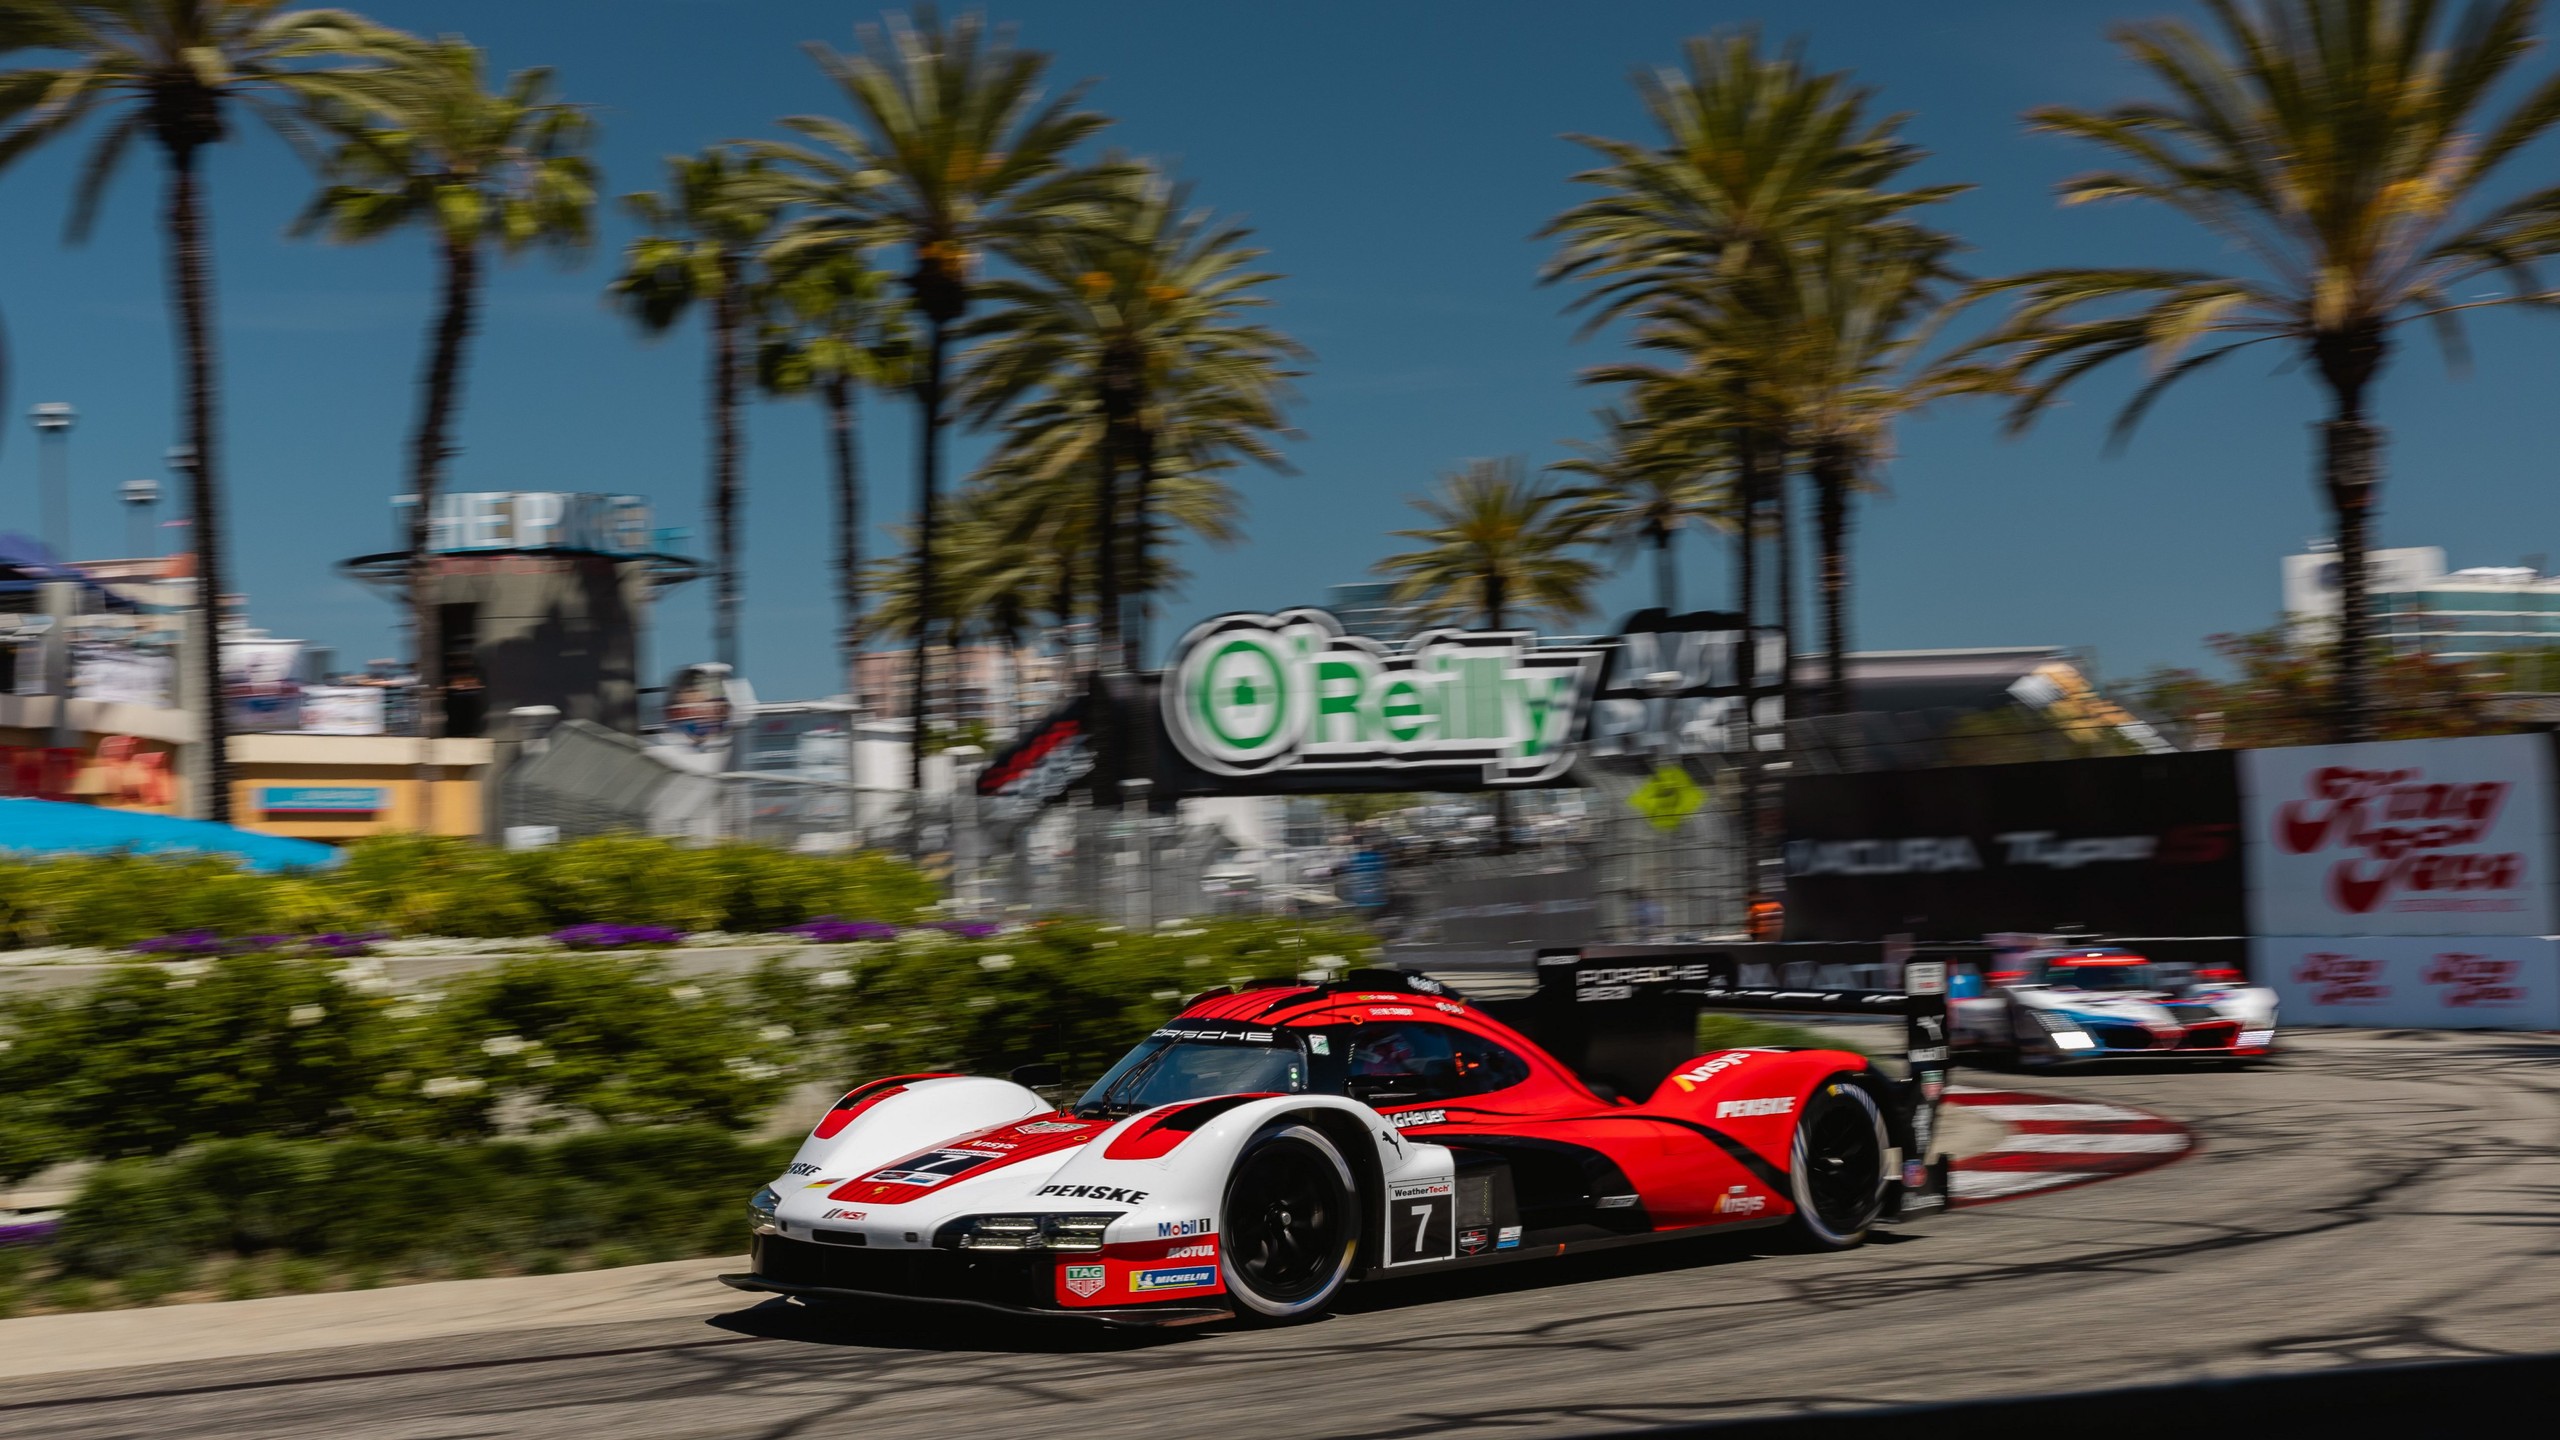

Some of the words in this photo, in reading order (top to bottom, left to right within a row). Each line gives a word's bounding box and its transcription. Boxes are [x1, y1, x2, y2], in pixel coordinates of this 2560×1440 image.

[1188, 630, 1582, 765] O'Reilly
[1576, 964, 1709, 986] PORSCHE
[1715, 1097, 1796, 1119] PENSKE
[914, 1154, 971, 1172] 7
[1036, 1185, 1149, 1205] PENSKE
[1395, 1184, 1449, 1197] WeatherTech
[1158, 1220, 1197, 1237] Mobil
[1200, 1218, 1210, 1232] 1
[1411, 1204, 1432, 1252] 7
[1166, 1245, 1215, 1259] MOTUL
[1071, 1266, 1102, 1278] TAG
[1155, 1272, 1209, 1284] MICHELIN
